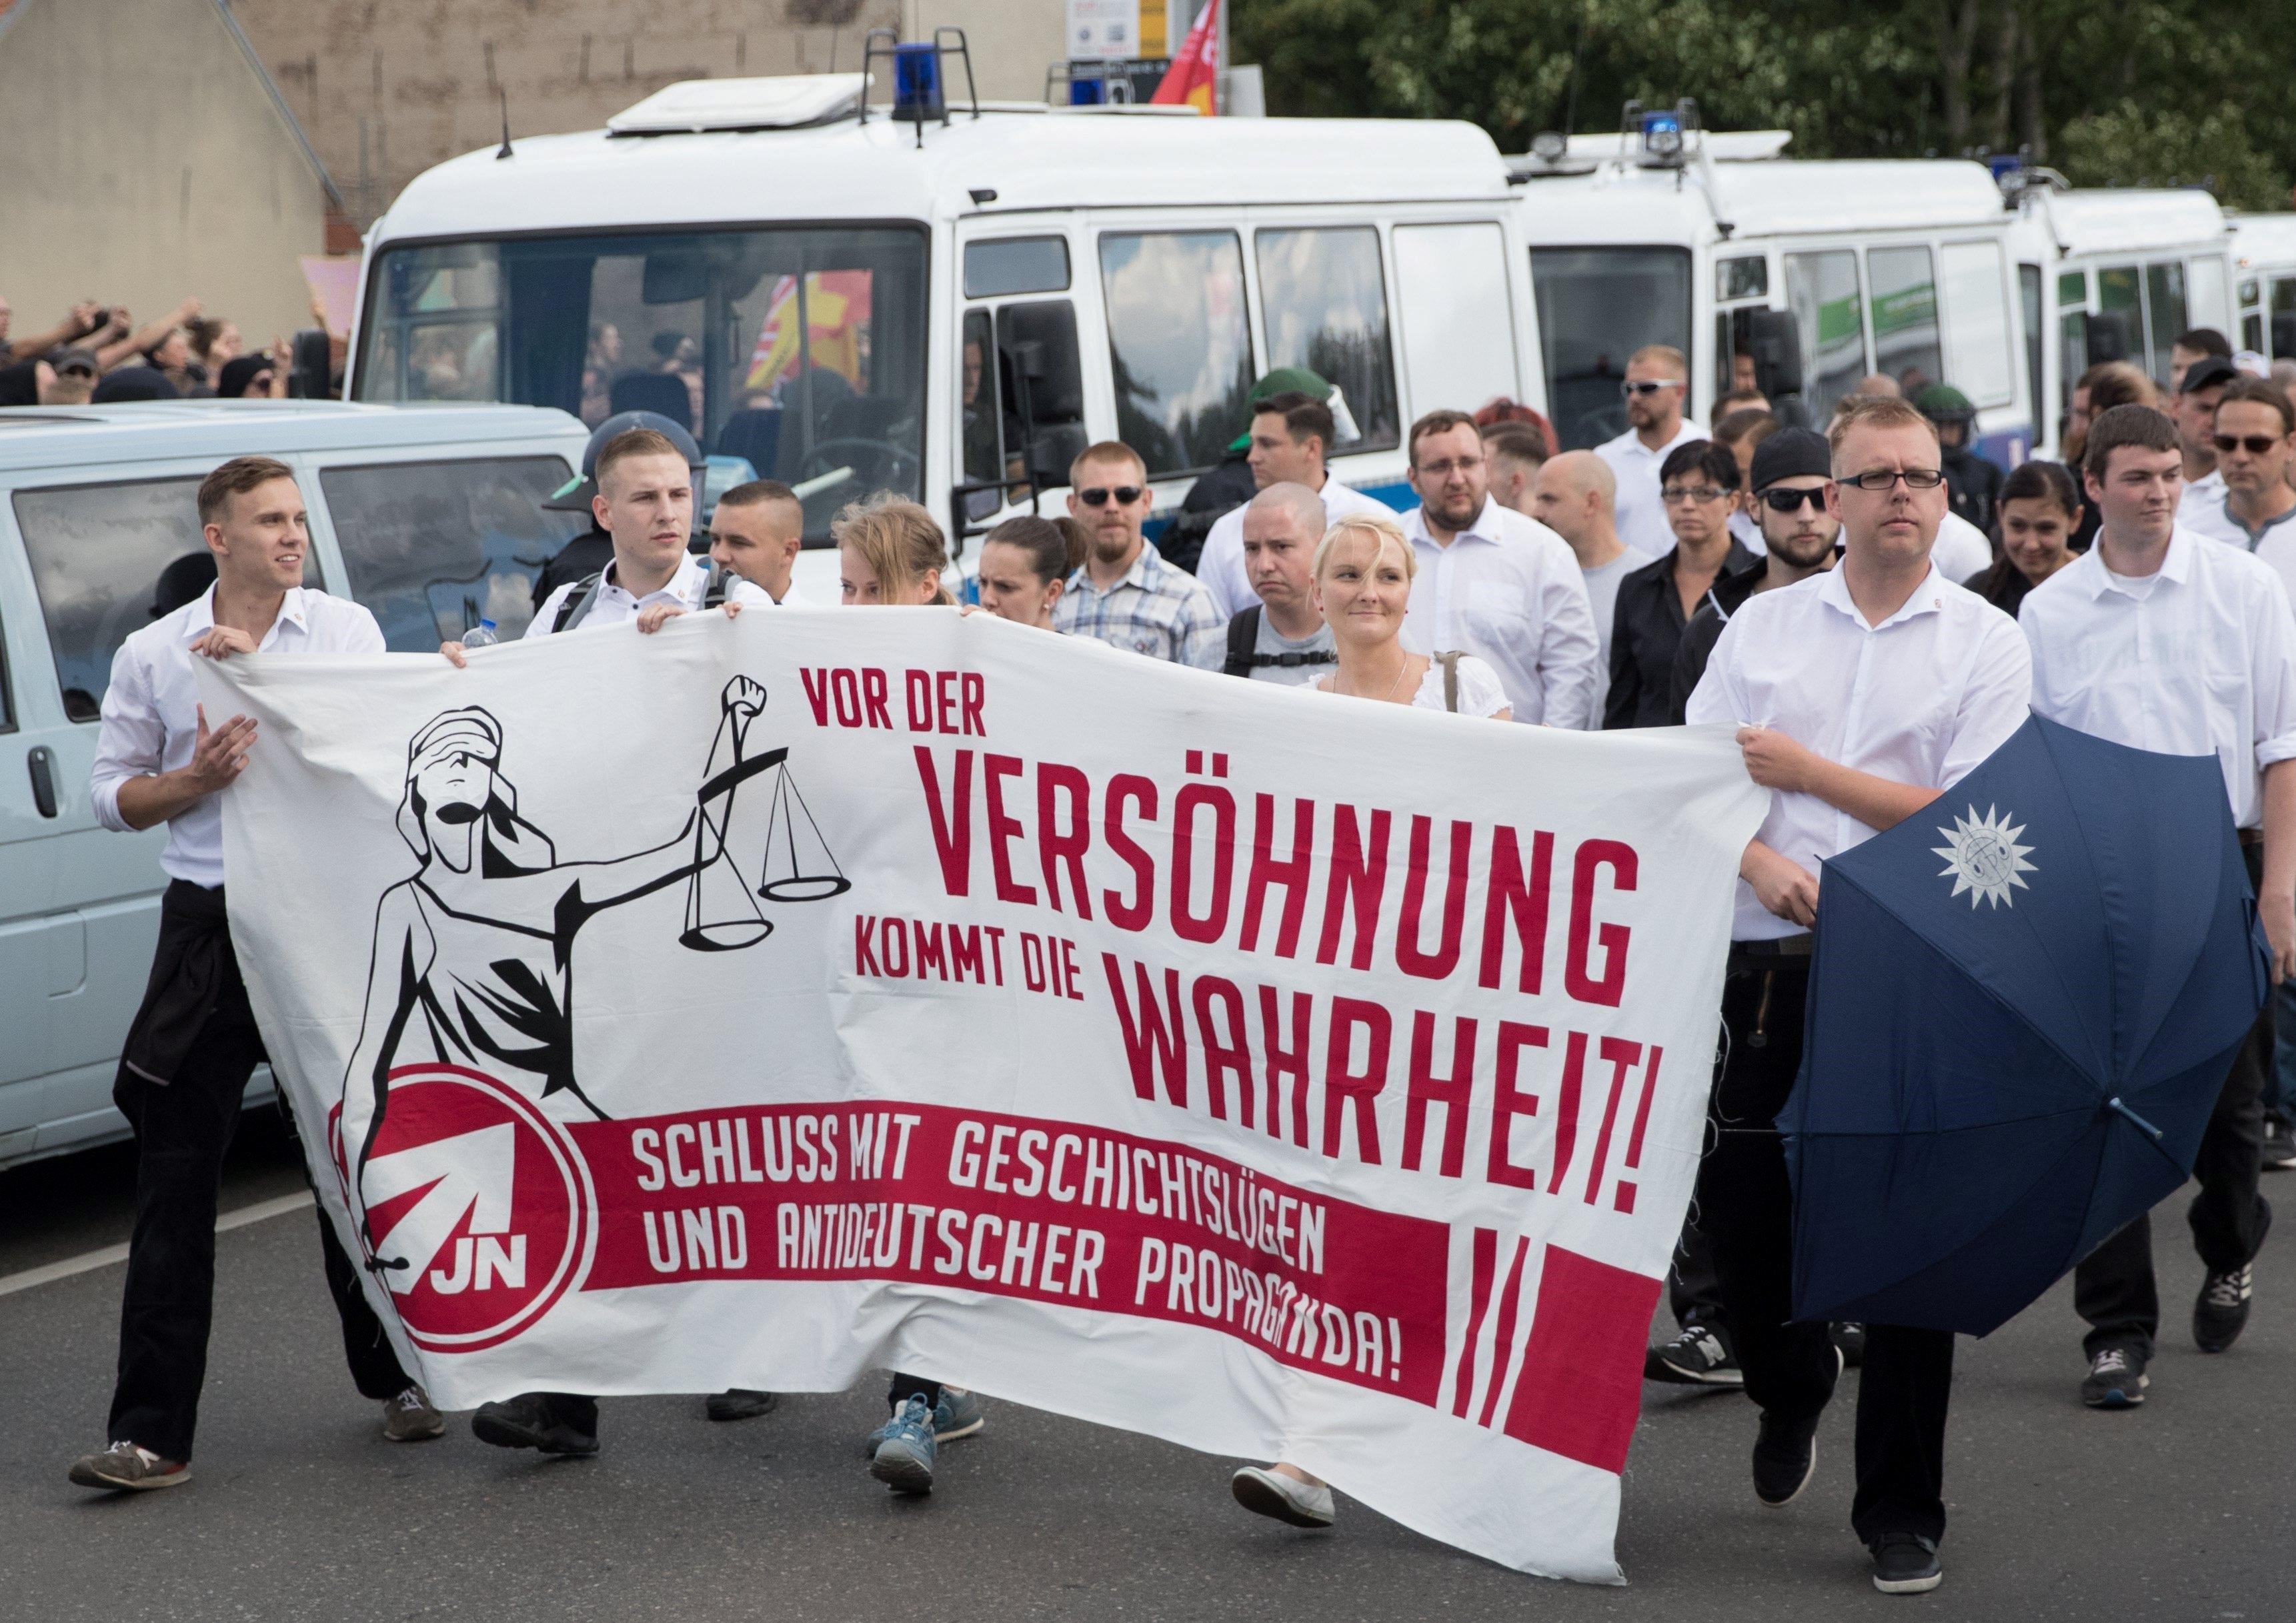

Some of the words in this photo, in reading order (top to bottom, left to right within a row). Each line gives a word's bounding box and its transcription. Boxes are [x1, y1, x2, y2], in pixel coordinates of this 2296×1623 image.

[800, 667, 893, 730] VOR
[906, 669, 986, 737] DER
[855, 914, 1005, 987] KOMMT
[1020, 932, 1084, 1001] DIE
[913, 745, 1639, 1008] VERSÖHNUNG
[1101, 952, 1664, 1215] WAHRHEIT!
[429, 1234, 527, 1295] JN
[631, 1114, 838, 1192] SCHLUSS
[849, 1112, 922, 1181] MIT
[948, 1120, 1326, 1275] GESCHICHTSLÜGEN
[643, 1205, 748, 1273] UND
[777, 1202, 1106, 1299] ANTIDEUTSCHER
[1134, 1236, 1401, 1383] PROPAGANDA!
